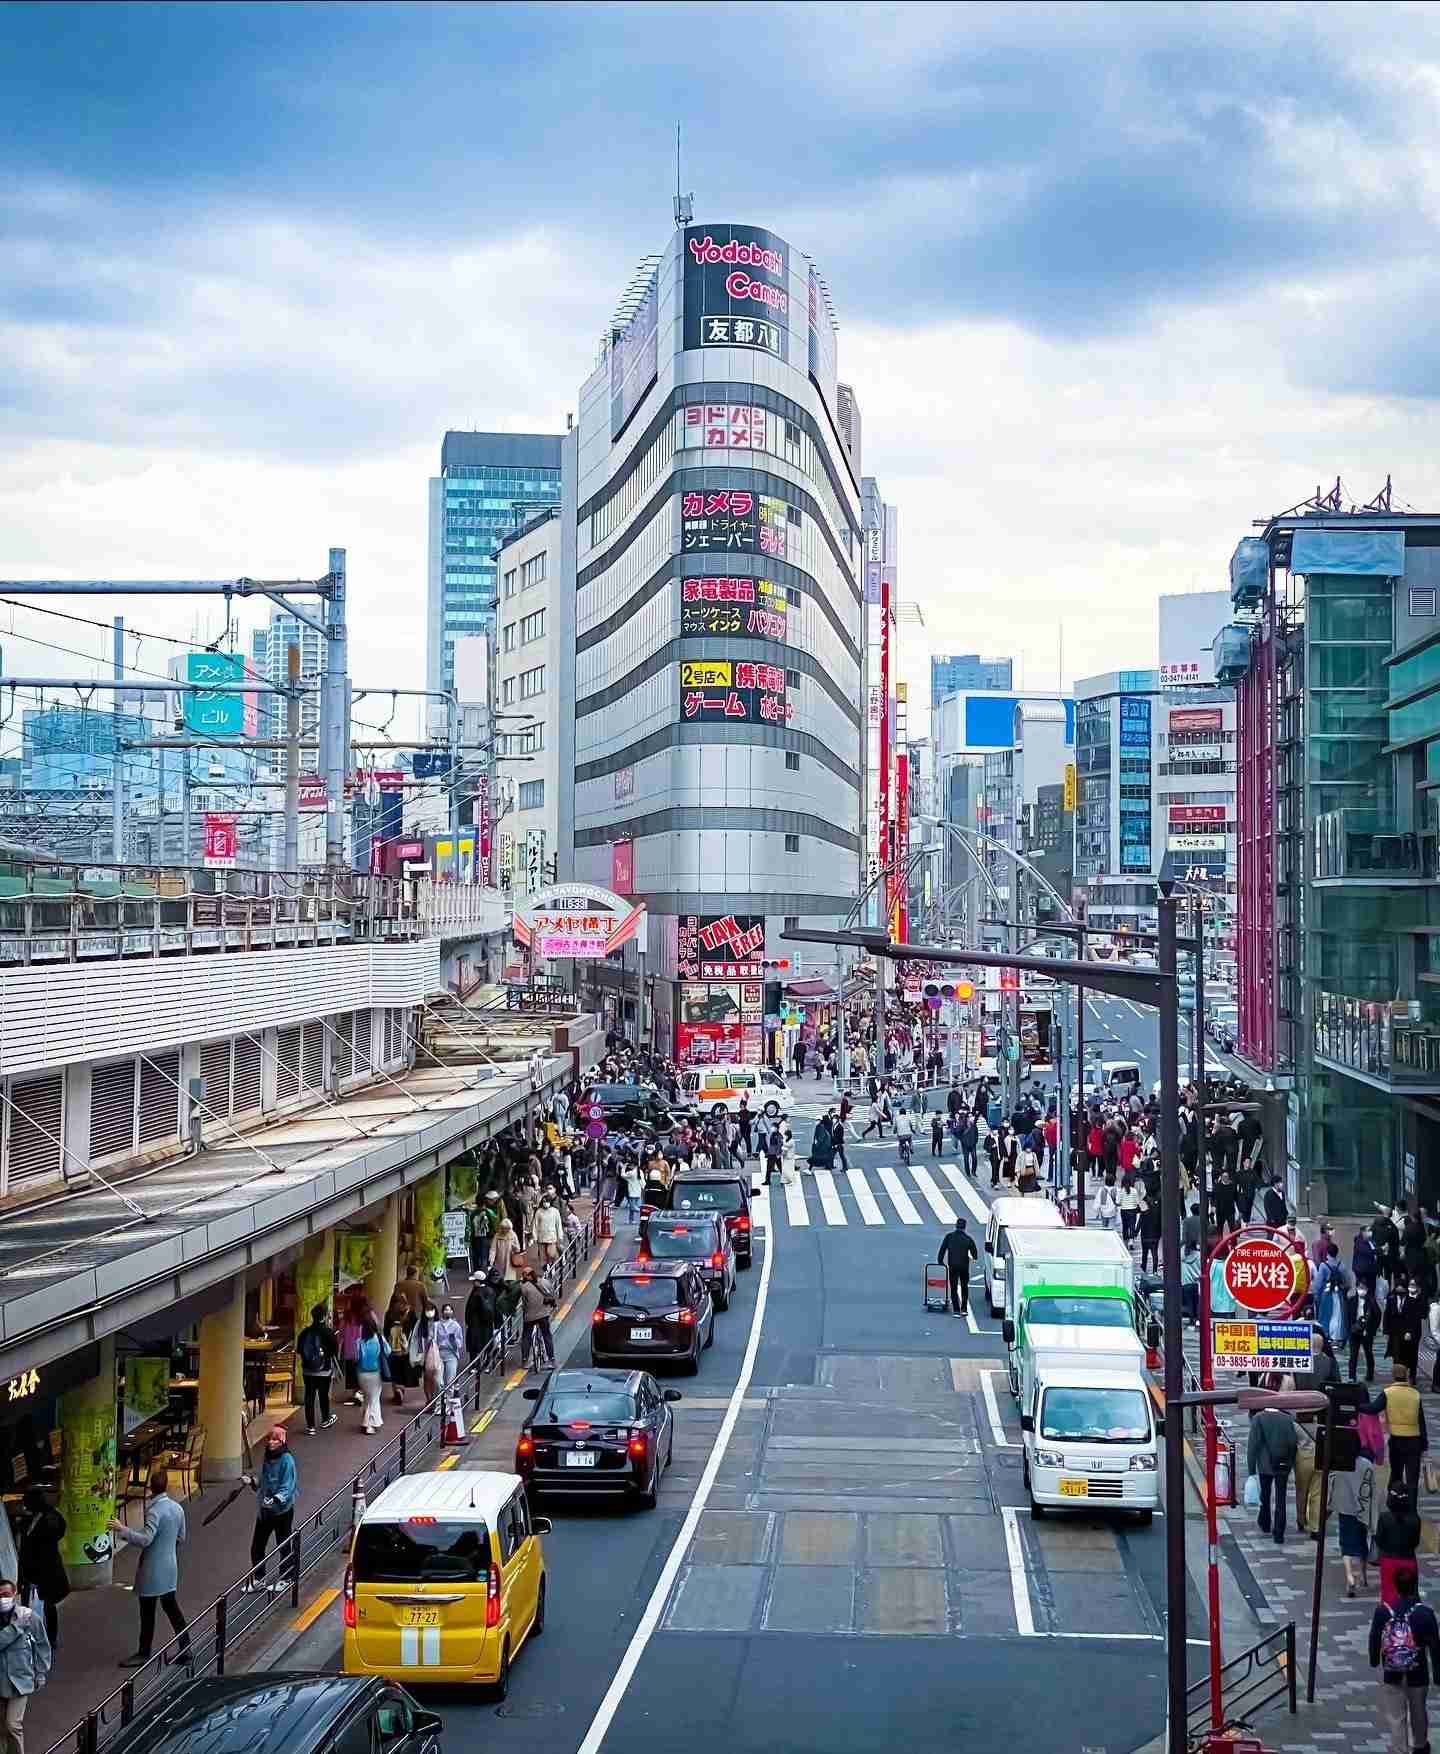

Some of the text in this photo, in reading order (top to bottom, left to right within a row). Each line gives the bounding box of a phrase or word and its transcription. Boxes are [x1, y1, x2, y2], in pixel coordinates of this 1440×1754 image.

[726, 272, 787, 313] Camera
[687, 407, 766, 429] ヨドバシ
[707, 429, 765, 446] カメラ
[683, 492, 752, 516] カメラ
[711, 520, 757, 532] ドライヤー
[684, 533, 754, 548] シェーバー
[683, 579, 754, 602] 家電製品
[683, 607, 741, 619] スーツケース
[683, 620, 741, 632] マウス インク
[683, 667, 728, 685] 2号店へ
[684, 692, 746, 717] ゲーム
[697, 914, 743, 951] TAX
[1236, 1249, 1283, 1258] FIRE HYDRANT
[1231, 1261, 1290, 1289] 消火栓
[1223, 1339, 1251, 1352] 対応
